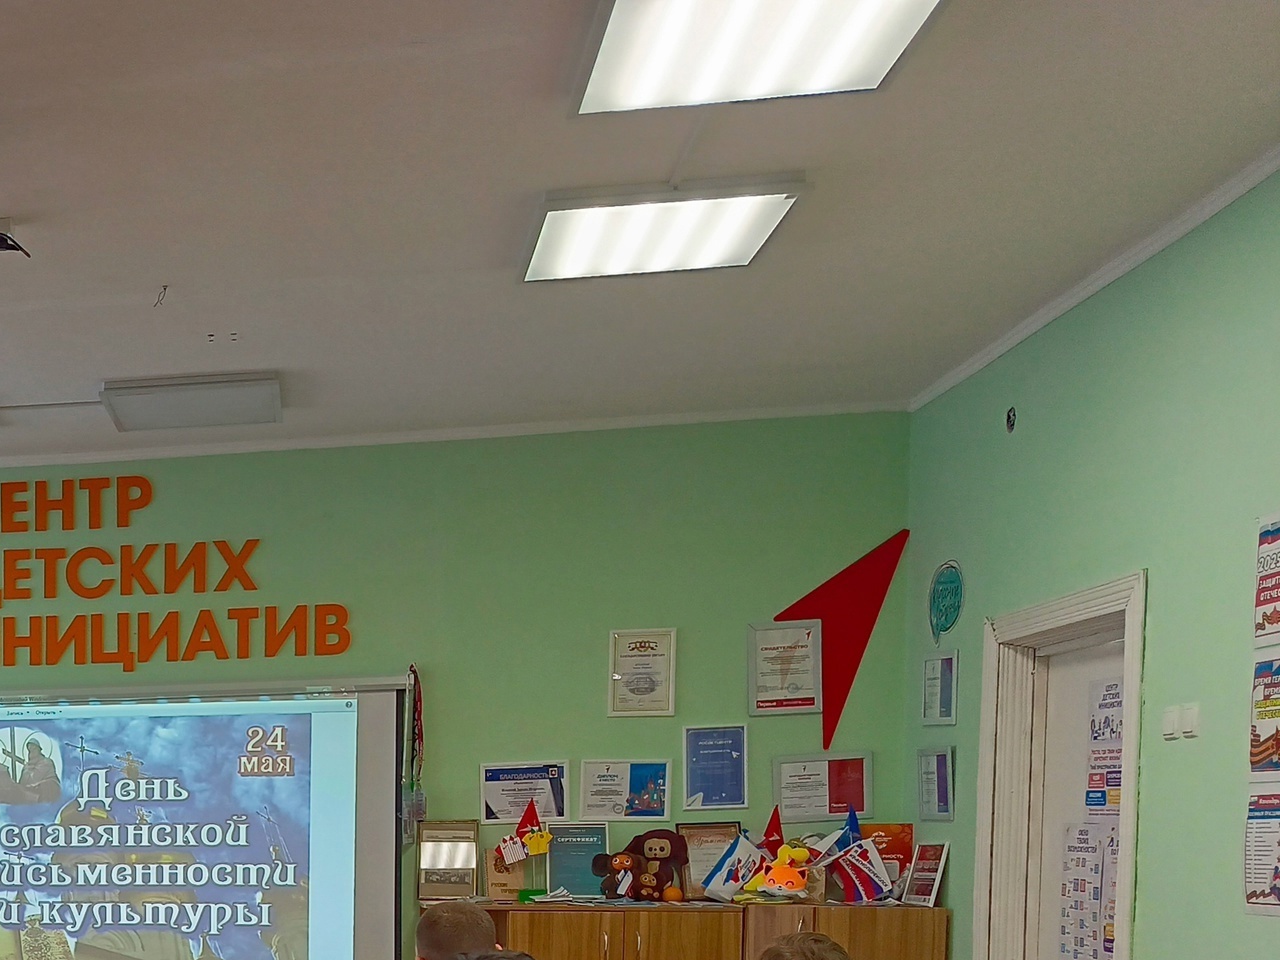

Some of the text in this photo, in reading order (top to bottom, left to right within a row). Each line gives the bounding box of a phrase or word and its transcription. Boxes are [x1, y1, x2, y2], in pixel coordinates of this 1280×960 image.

[245, 725, 287, 753] 24
[237, 755, 292, 774] мая
[499, 772, 549, 780] БЛАГОДАРНОСТЬ
[76, 768, 189, 811] День
[0, 815, 251, 849] славянской
[40, 899, 273, 935] культуры
